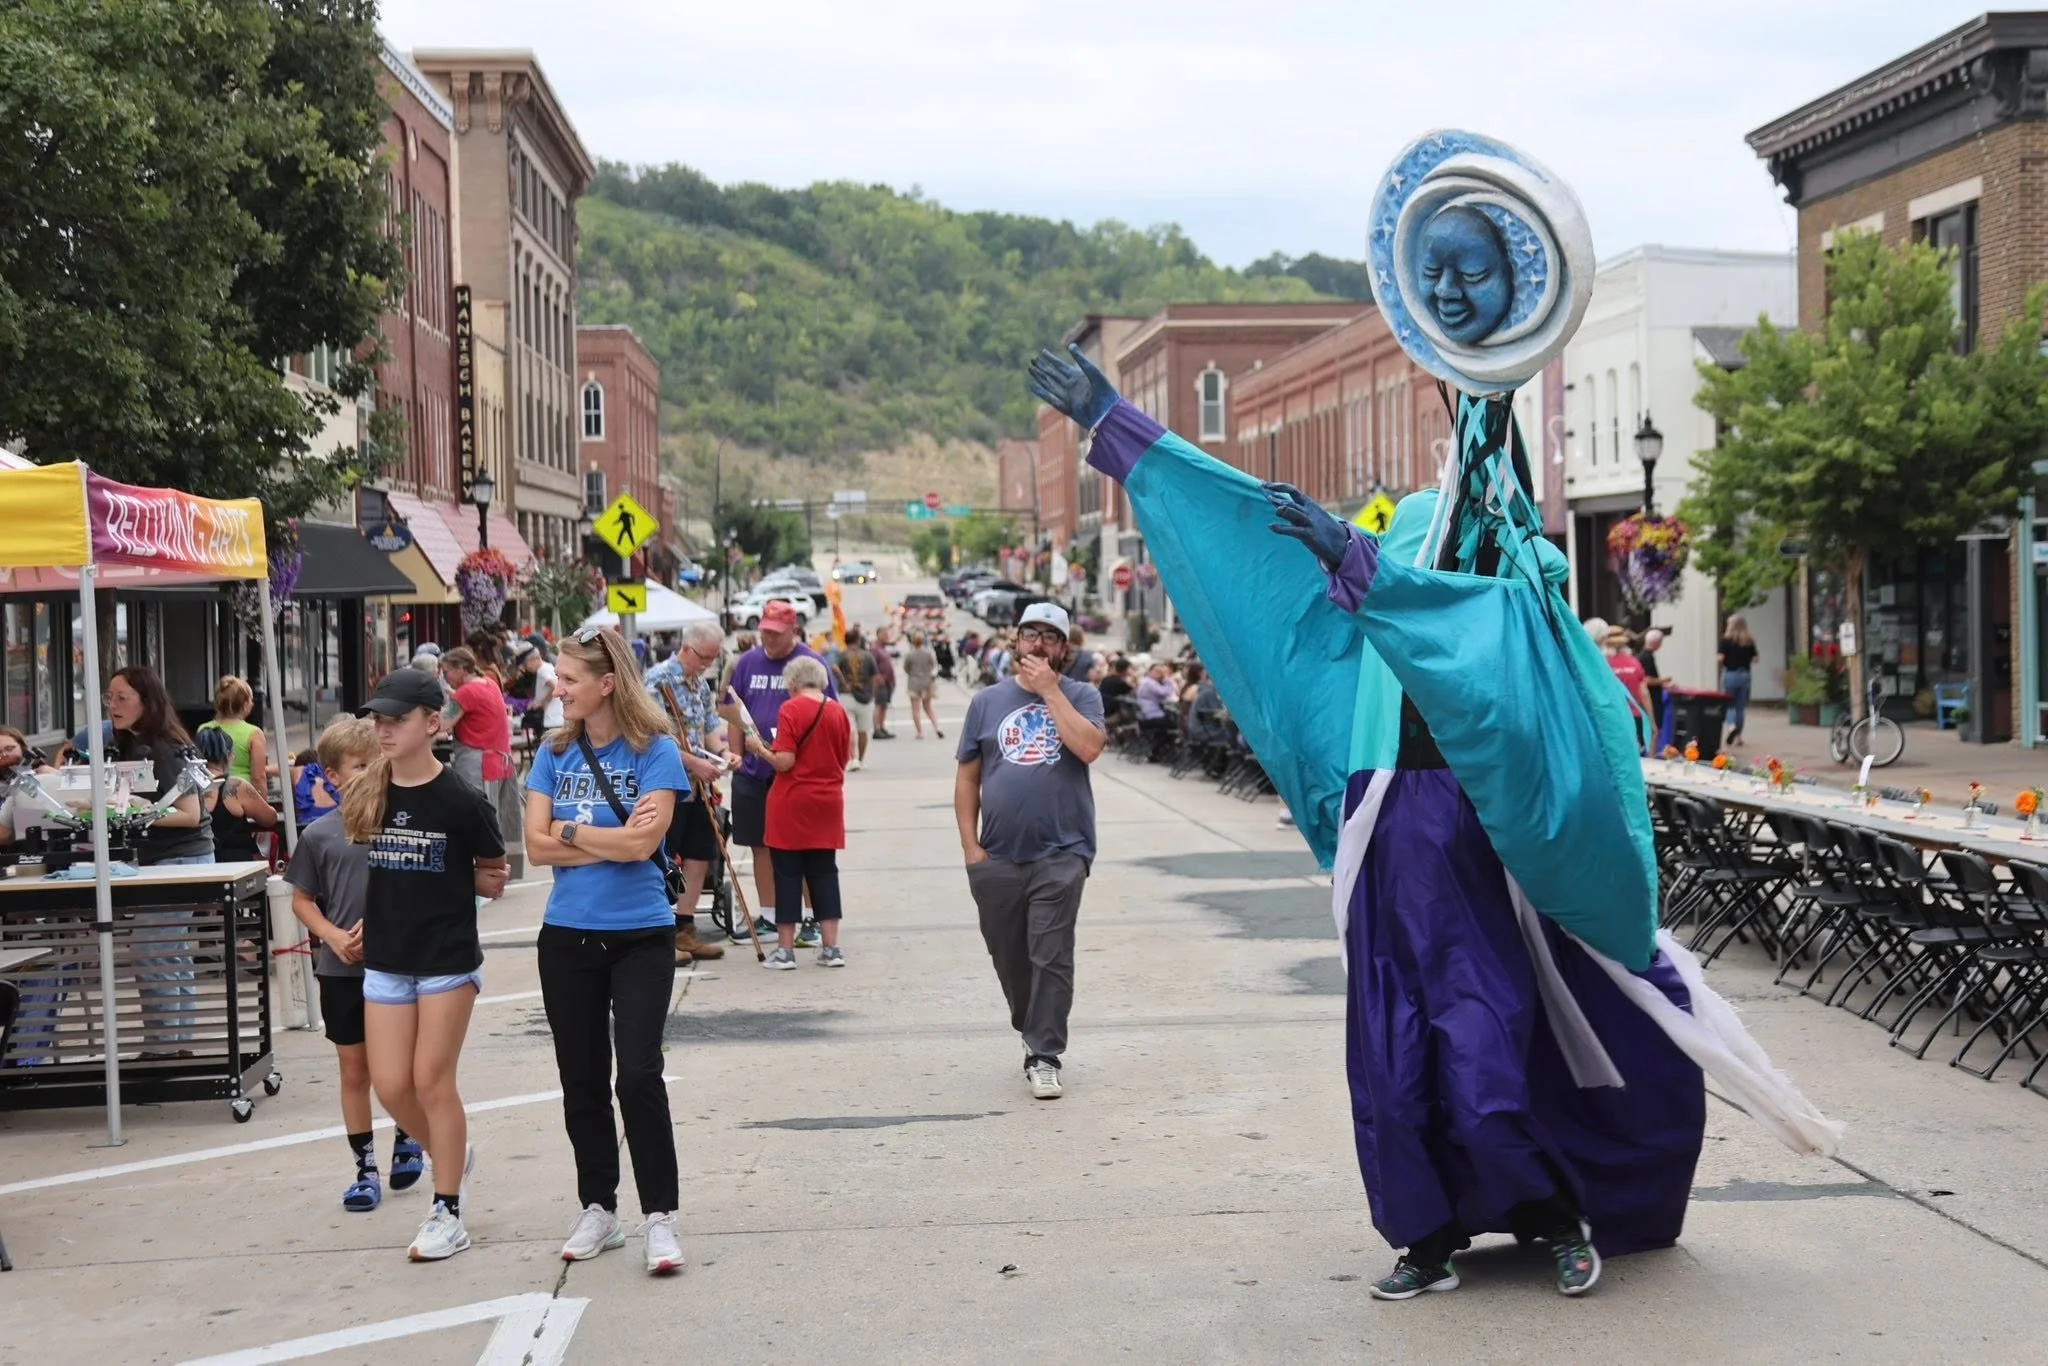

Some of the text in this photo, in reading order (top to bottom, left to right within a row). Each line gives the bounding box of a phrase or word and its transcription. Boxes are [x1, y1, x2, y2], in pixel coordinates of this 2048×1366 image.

[457, 290, 474, 498] HANISCH BAKERY
[103, 489, 254, 566] RED WING ARTS
[750, 675, 785, 690] RED WI
[1005, 727, 1020, 745] 19 80
[1045, 718, 1057, 748] USA
[581, 762, 612, 770] SALL
[554, 774, 640, 800] ABES
[368, 834, 431, 853] TUDENT
[368, 850, 431, 871] OUNCIL
[432, 841, 445, 871] 2025
